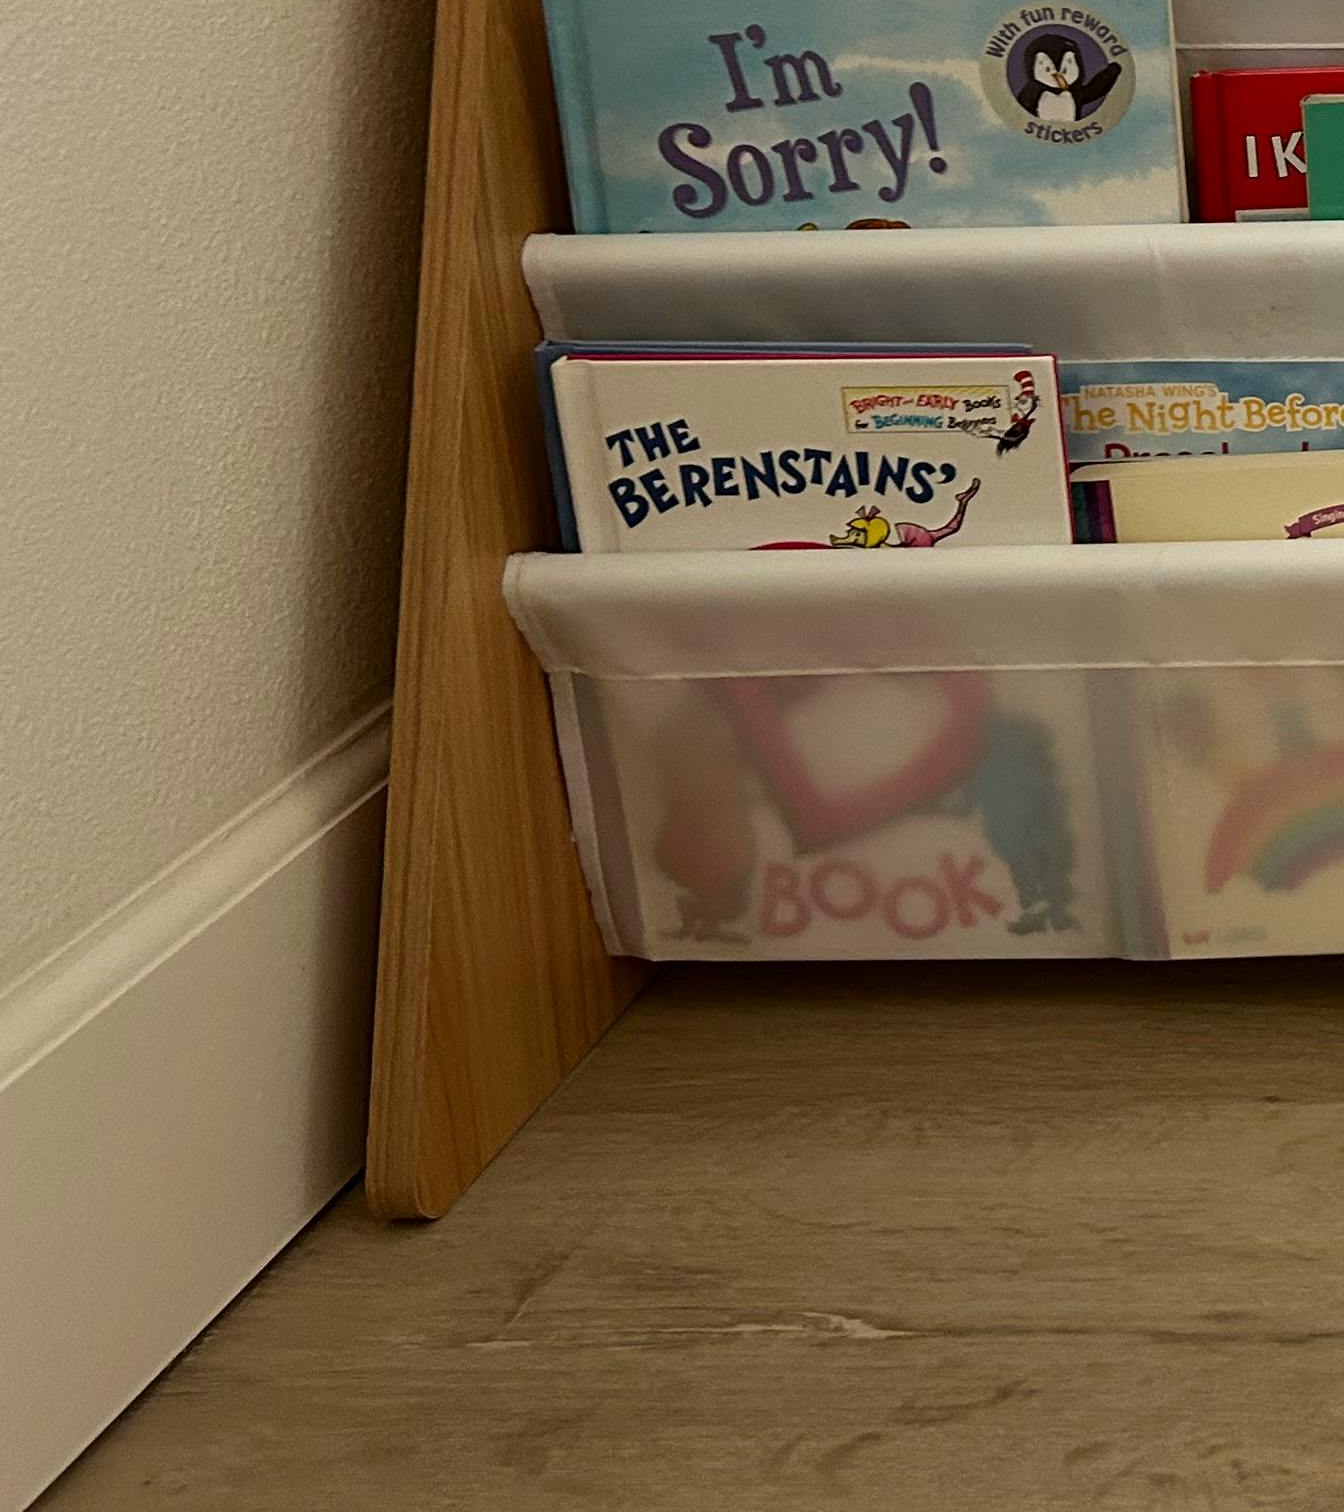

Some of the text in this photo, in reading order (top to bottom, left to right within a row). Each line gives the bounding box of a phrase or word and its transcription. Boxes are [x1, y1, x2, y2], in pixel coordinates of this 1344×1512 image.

[986, 7, 1129, 59] With fun reward
[708, 23, 844, 114] I'm
[657, 82, 948, 220] Sorry!
[1024, 121, 1103, 144] stickers
[1245, 135, 1258, 178] I
[850, 394, 903, 414] BRIGHT
[916, 394, 960, 410] EARLY
[963, 395, 1001, 412] Books
[1084, 384, 1218, 399] NATASHA WING'S
[1127, 395, 1235, 433] Night
[604, 418, 701, 470] THE
[759, 850, 1003, 940] BOOK
